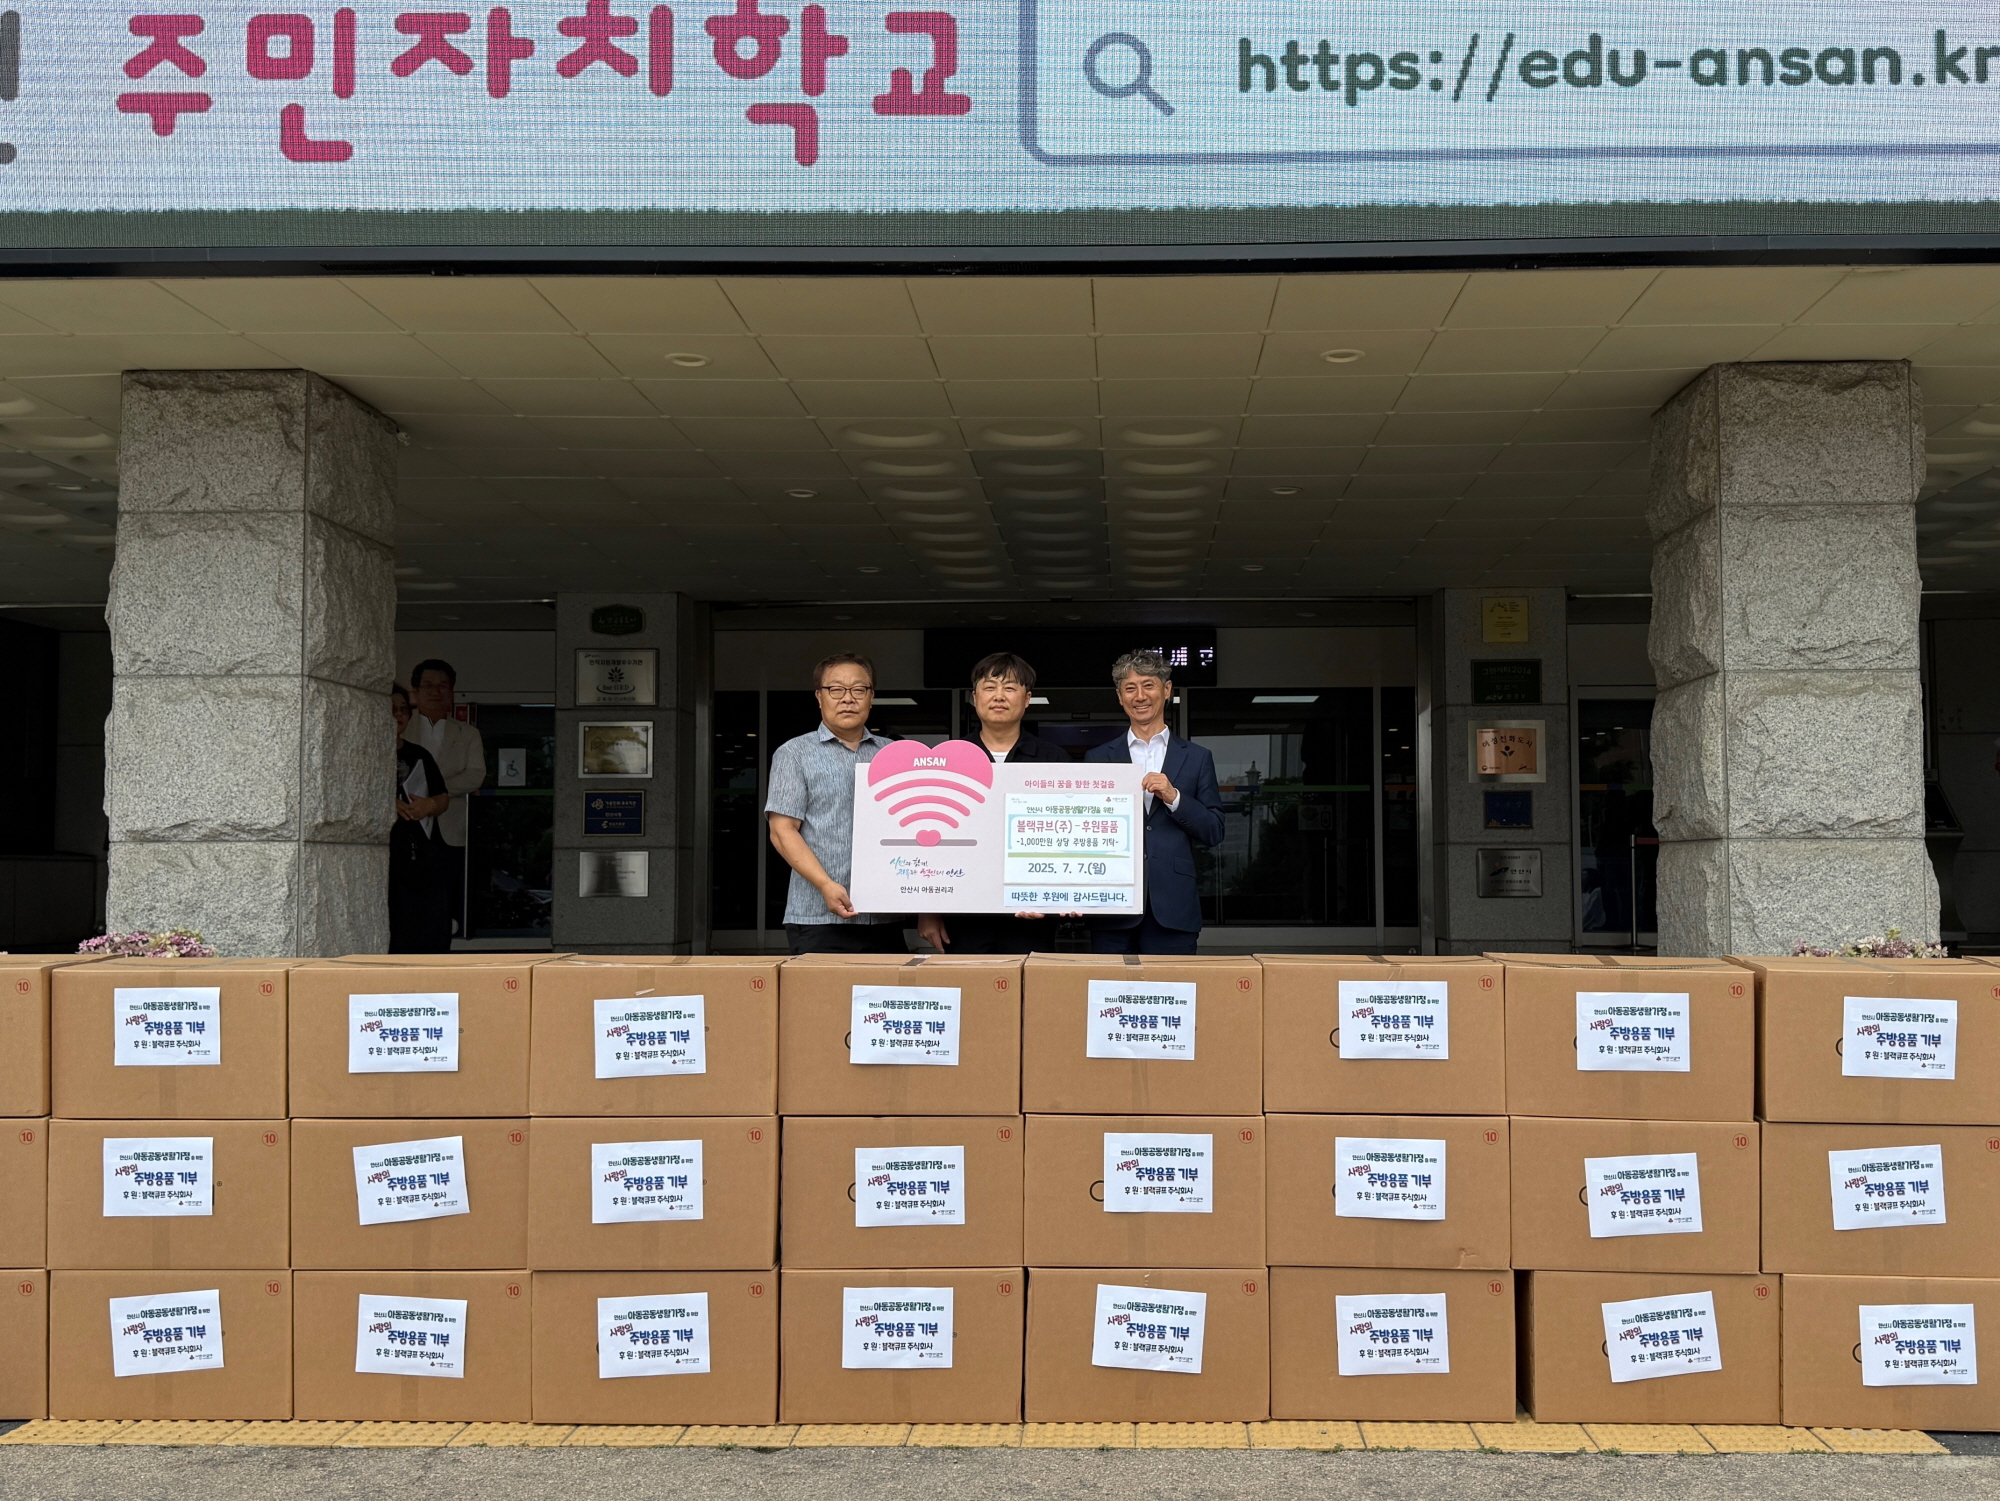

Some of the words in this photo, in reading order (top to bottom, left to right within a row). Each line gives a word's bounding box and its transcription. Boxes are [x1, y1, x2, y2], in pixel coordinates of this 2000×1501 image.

[1237, 30, 2000, 104] https://edu-ansan.kr
[115, 0, 972, 166] 주민자치학교
[1482, 735, 1533, 748] 여성친화도시
[913, 757, 947, 767] ANSAN
[1024, 780, 1055, 789] 아이들의
[1057, 780, 1073, 788] 꿈을
[1075, 780, 1090, 788] 향한
[1092, 780, 1115, 789] 첫걸음
[1016, 820, 1073, 834] 블랙큐브(주)
[1082, 820, 1118, 833] 후원물품
[1016, 838, 1053, 847] -1,000만원
[1056, 838, 1070, 847] 상당
[1072, 838, 1098, 847] 주방용품
[1028, 862, 1057, 874] 2025.
[1062, 863, 1072, 874] 7.
[1078, 862, 1106, 875] 7.(월)
[1011, 892, 1038, 902] 따뜻한
[1042, 892, 1069, 902] 후원에
[1073, 892, 1128, 902] 감사드립니다.
[18, 982, 30, 991] 10
[262, 984, 274, 993] 10
[506, 980, 518, 990] 10
[752, 979, 764, 989] 10
[996, 980, 1007, 990] 10
[1239, 980, 1250, 990] 10
[1481, 979, 1492, 988] 10
[1732, 986, 1743, 996] 10
[863, 1011, 886, 1023] 사랑의
[1100, 1006, 1122, 1018] 사랑의
[1352, 1006, 1374, 1018] 사랑의
[125, 1013, 148, 1025] 사랑의
[1119, 1014, 1158, 1029] 주방용품
[1161, 1016, 1181, 1029] 기부
[1371, 1015, 1410, 1029] 주방용품
[1413, 1015, 1434, 1028] 기부
[1590, 1018, 1613, 1030] 사랑의
[144, 1021, 183, 1035] 주방용품
[185, 1021, 205, 1034] 기부
[360, 1020, 383, 1032] 사랑의
[606, 1024, 630, 1037] 사랑의
[882, 1020, 922, 1035] 주방용품
[925, 1021, 945, 1034] 기부
[1857, 1024, 1880, 1036] 사랑의
[379, 1028, 419, 1042] 주방용품
[422, 1027, 443, 1040] 기부
[626, 1031, 666, 1046] 주방용품
[669, 1029, 690, 1043] 기부
[1404, 1034, 1429, 1042] 주식회사
[1609, 1027, 1651, 1041] 주방용품
[1653, 1027, 1675, 1041] 기부
[1876, 1032, 1917, 1047] 주방용품
[1920, 1034, 1941, 1048] 기부
[176, 1040, 200, 1048] 주식회사
[22, 1132, 34, 1142] 10
[264, 1134, 276, 1144] 10
[511, 1133, 523, 1143] 10
[750, 1131, 761, 1141] 10
[1000, 1130, 1011, 1139] 10
[1241, 1131, 1253, 1142] 10
[1485, 1132, 1497, 1142] 10
[1735, 1137, 1748, 1146] 10
[1989, 1140, 2000, 1150] 10
[115, 1163, 138, 1176] 사랑의
[1116, 1158, 1139, 1171] 사랑의
[1348, 1164, 1371, 1176] 사랑의
[134, 1172, 174, 1186] 주방용품
[177, 1171, 197, 1185] 기부
[367, 1169, 390, 1184] 사랑의
[604, 1169, 627, 1182] 사랑의
[867, 1173, 890, 1186] 사랑의
[1135, 1167, 1175, 1182] 주방용품
[1178, 1168, 1198, 1181] 기부
[1367, 1173, 1408, 1188] 주방용품
[1410, 1174, 1431, 1188] 기부
[387, 1174, 427, 1191] 주방용품
[429, 1172, 450, 1185] 기부
[623, 1176, 664, 1191] 주방용품
[667, 1175, 687, 1189] 기부
[887, 1181, 927, 1196] 주방용품
[929, 1180, 950, 1194] 기부
[1844, 1175, 1867, 1189] 사랑의
[1864, 1181, 1905, 1197] 주방용품
[1907, 1179, 1929, 1194] 기부
[1600, 1182, 1623, 1196] 사랑의
[1620, 1189, 1661, 1205] 주방용품
[1663, 1188, 1685, 1202] 기부
[21, 1283, 34, 1293] 10
[268, 1283, 280, 1293] 10
[508, 1285, 520, 1296] 10
[751, 1285, 763, 1295] 10
[1000, 1283, 1011, 1293] 10
[1244, 1283, 1256, 1292] 10
[1490, 1283, 1502, 1293] 10
[1756, 1287, 1768, 1296] 10
[855, 1314, 878, 1327] 사랑의
[1107, 1313, 1130, 1325] 사랑의
[123, 1321, 146, 1335] 사랑의
[142, 1327, 183, 1343] 주방용품
[185, 1324, 206, 1338] 기부
[368, 1321, 392, 1333] 사랑의
[610, 1323, 633, 1336] 사랑의
[874, 1323, 915, 1337] 주방용품
[917, 1322, 938, 1336] 기부
[1126, 1322, 1166, 1339] 주방용품
[1169, 1326, 1189, 1341] 기부
[1350, 1321, 1373, 1334] 사랑의
[1619, 1326, 1642, 1341] 사랑의
[387, 1330, 427, 1346] 주방용품
[430, 1333, 449, 1347] 기부
[629, 1330, 670, 1345] 주방용품
[672, 1328, 693, 1342] 기부
[1369, 1329, 1410, 1344] 주방용품
[1412, 1328, 1433, 1342] 기부
[1638, 1330, 1680, 1348] 주방용품
[1681, 1327, 1703, 1341] 기부
[1874, 1331, 1898, 1344] 사랑의
[663, 1348, 689, 1357] 주식회사
[1894, 1340, 1937, 1354] 주방용품
[1939, 1339, 1961, 1353] 기부
